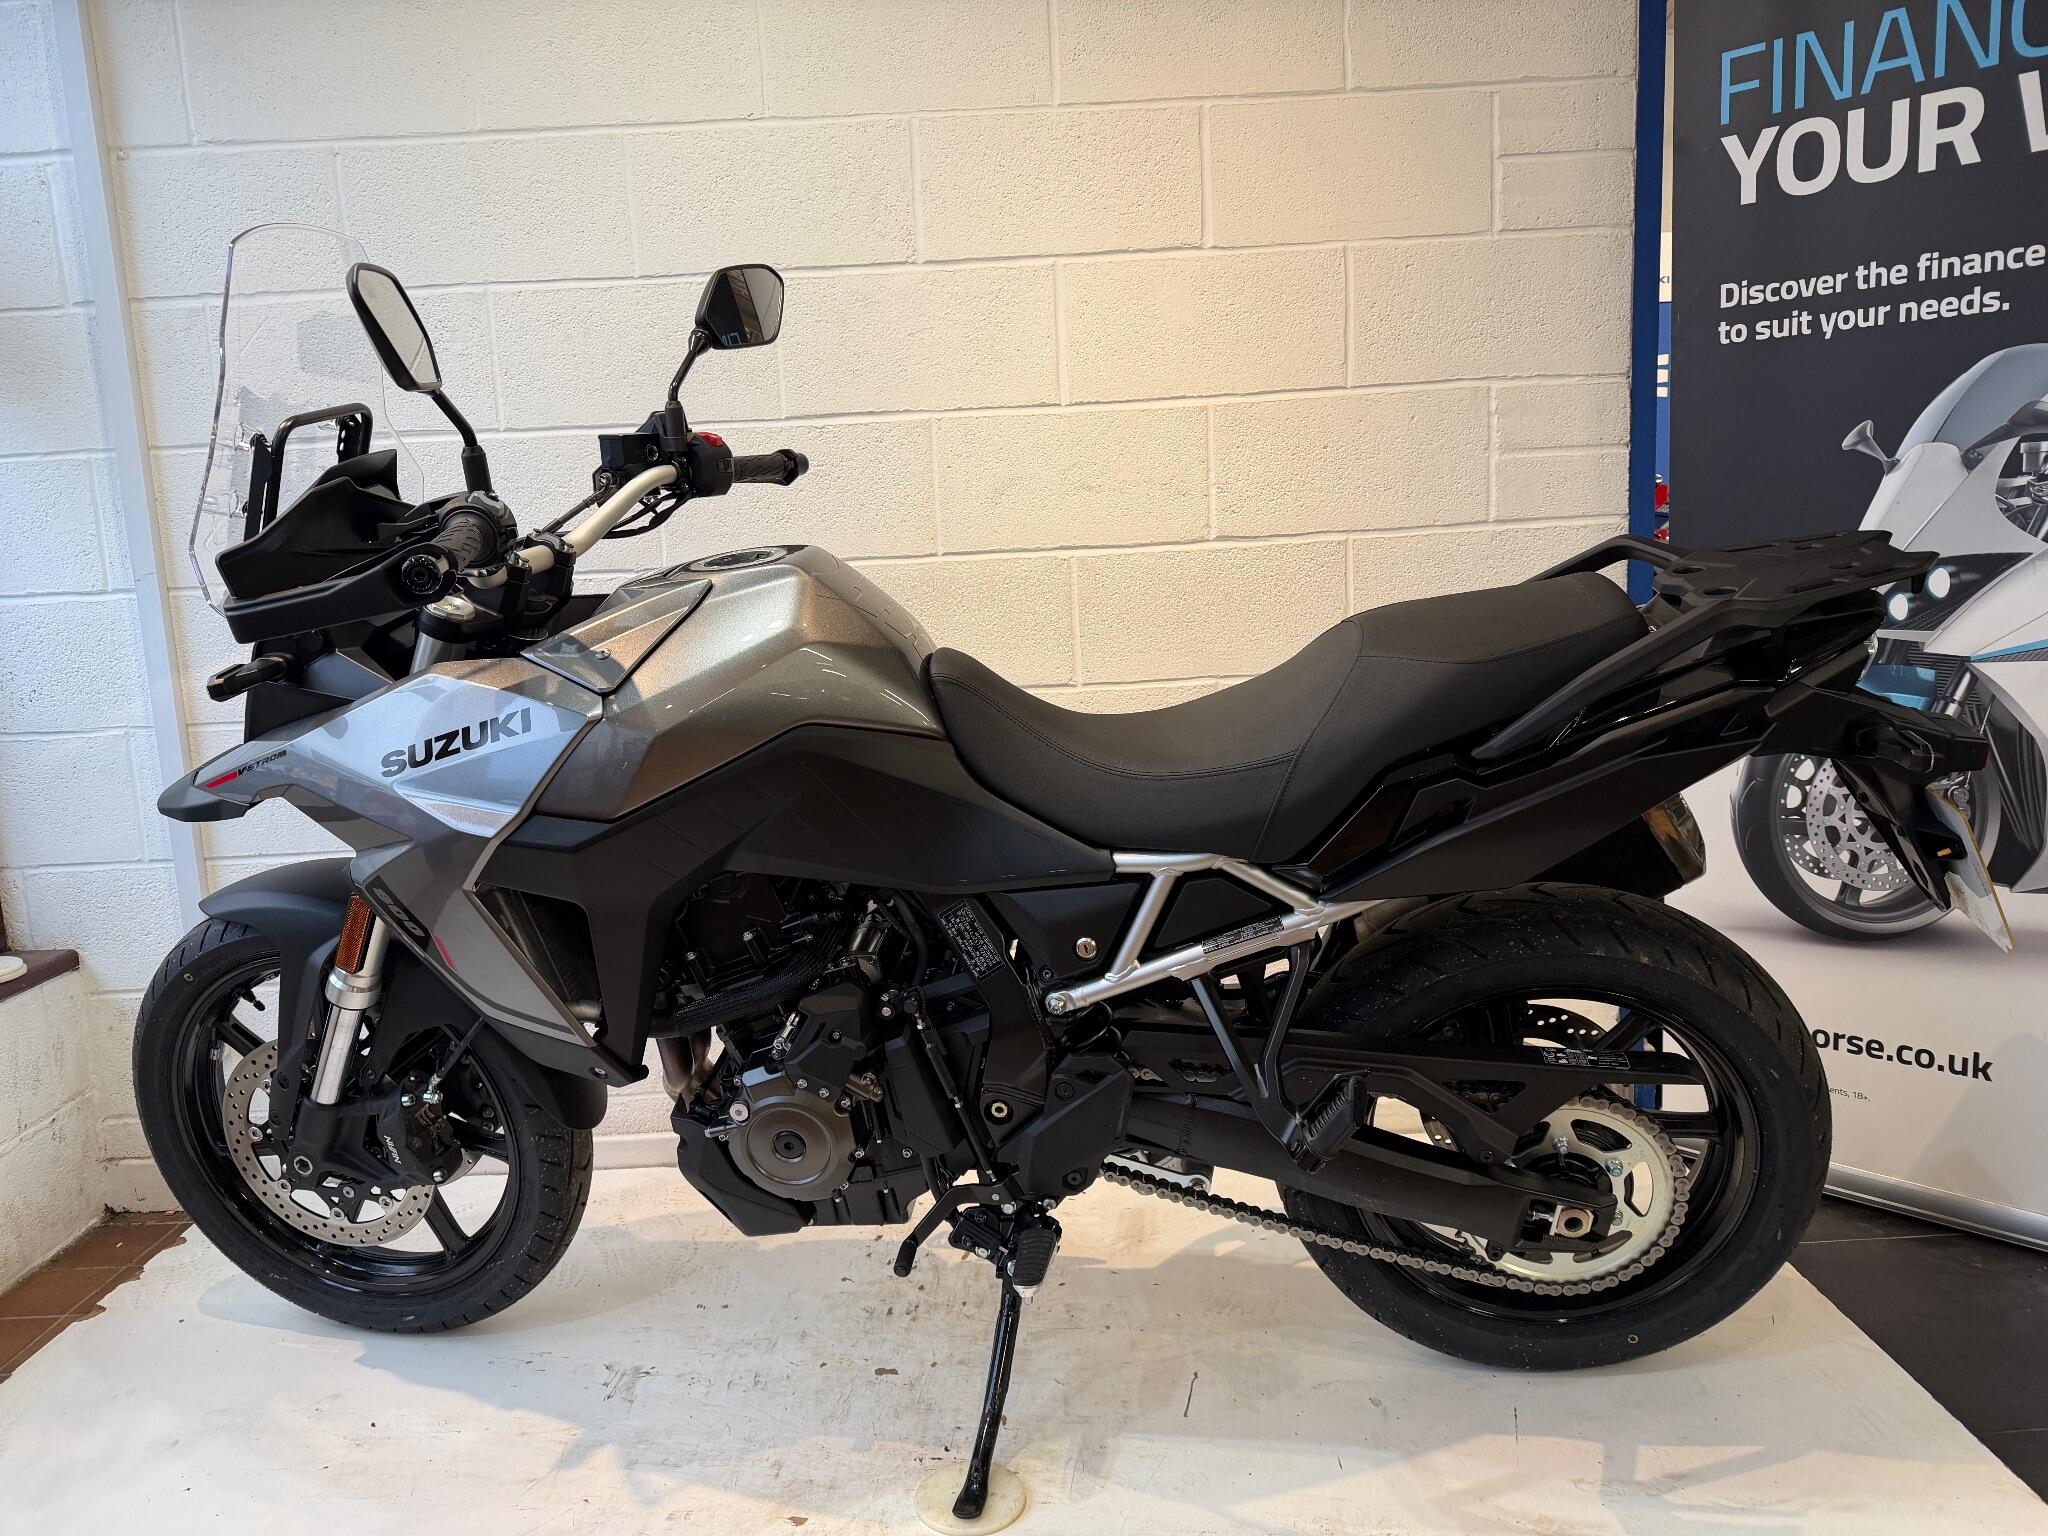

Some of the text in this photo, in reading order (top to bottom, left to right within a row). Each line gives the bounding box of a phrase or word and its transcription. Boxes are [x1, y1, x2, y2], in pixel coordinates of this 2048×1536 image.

[1720, 86, 1985, 205] YOUR
[1719, 244, 2047, 309] Discover the finance
[1718, 285, 2010, 345] to suit your needs.
[380, 706, 533, 778] SUZUKI
[372, 887, 426, 937] 800
